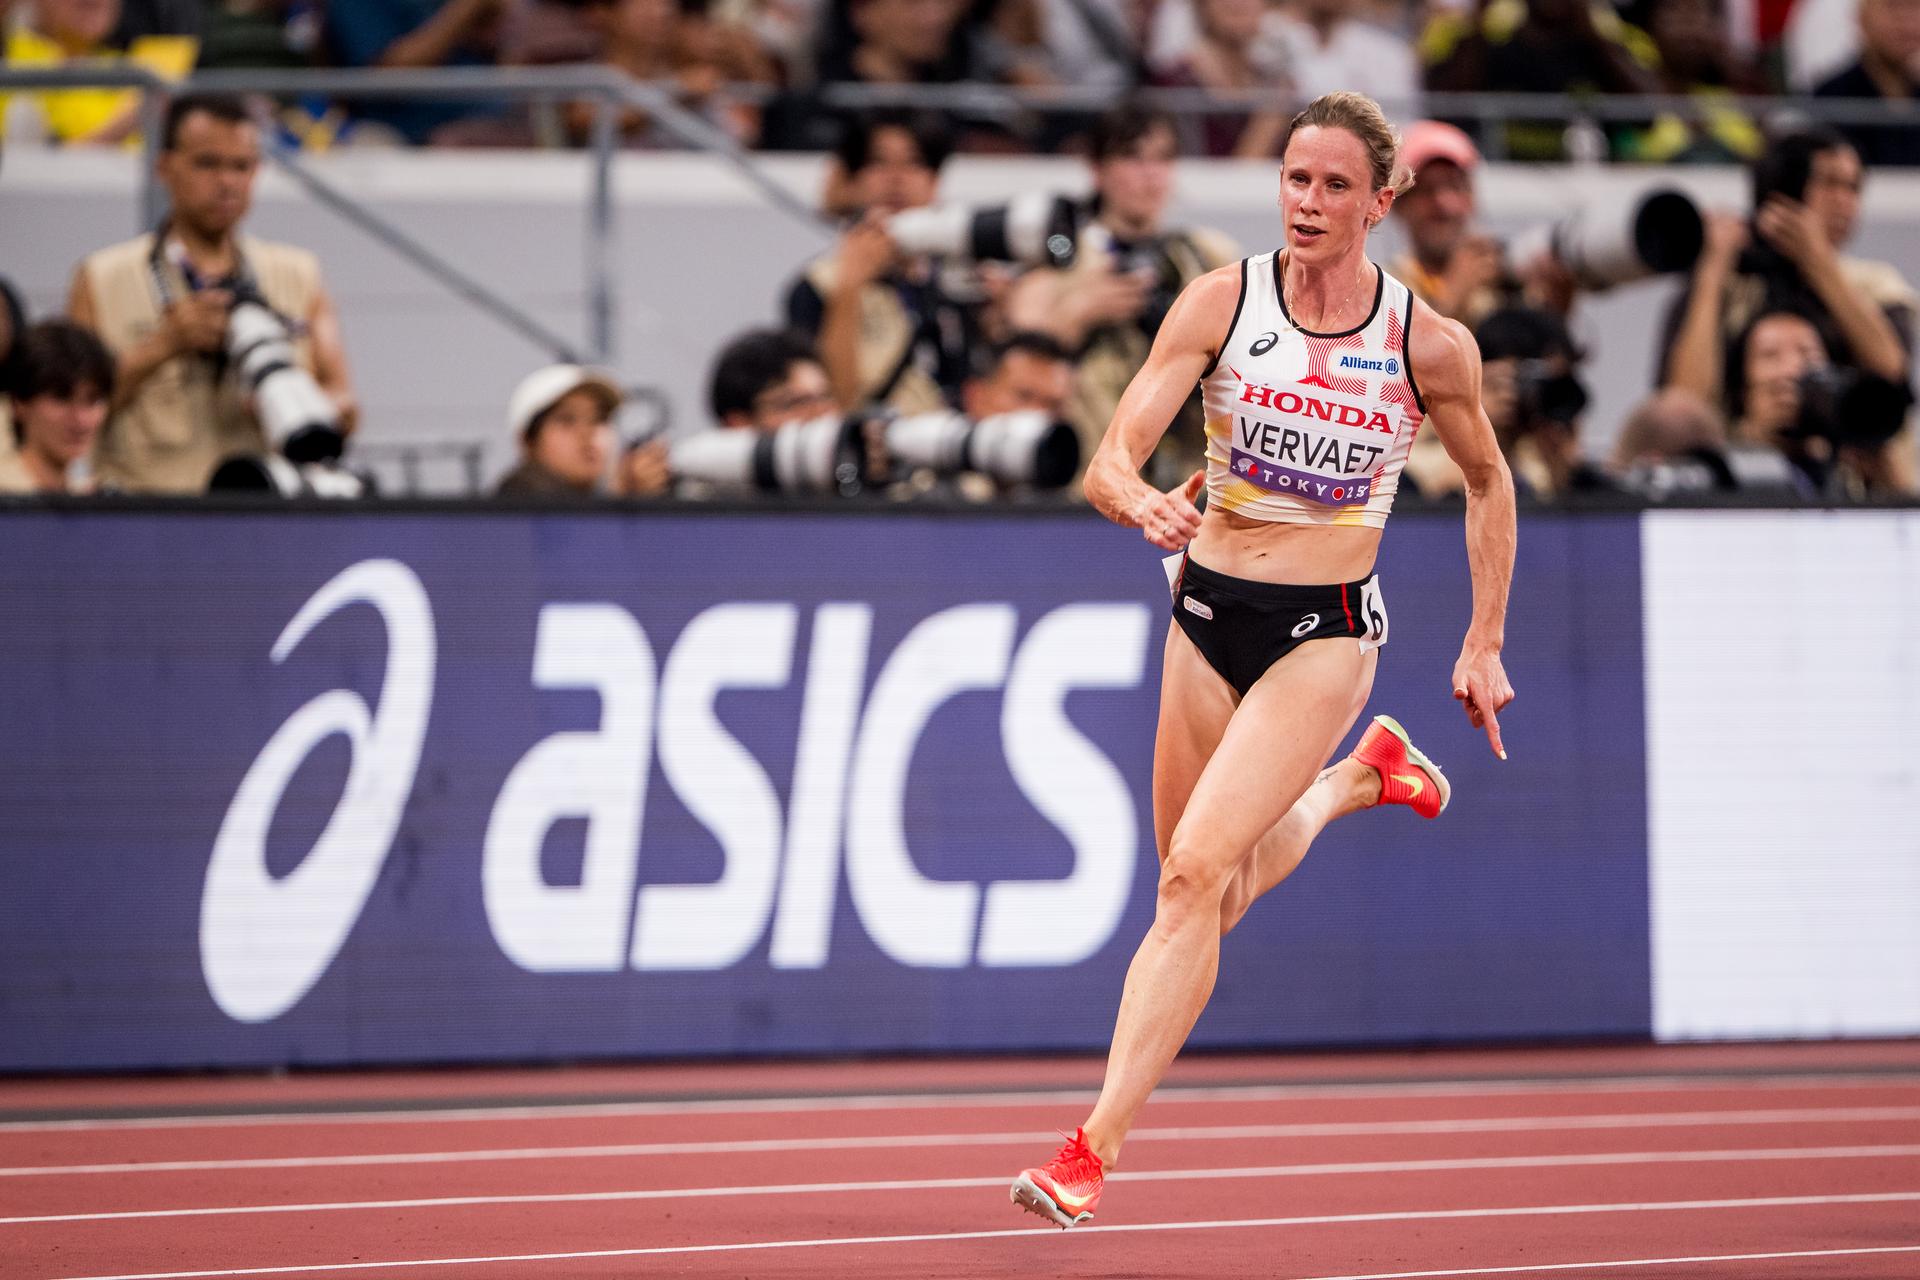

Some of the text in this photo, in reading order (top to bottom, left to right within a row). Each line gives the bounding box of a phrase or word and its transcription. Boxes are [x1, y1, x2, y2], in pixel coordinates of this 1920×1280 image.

[1340, 356, 1382, 370] Allianz
[1239, 383, 1394, 434] HONDA
[1240, 416, 1384, 475] VERVAET
[1367, 593, 1383, 641] 6
